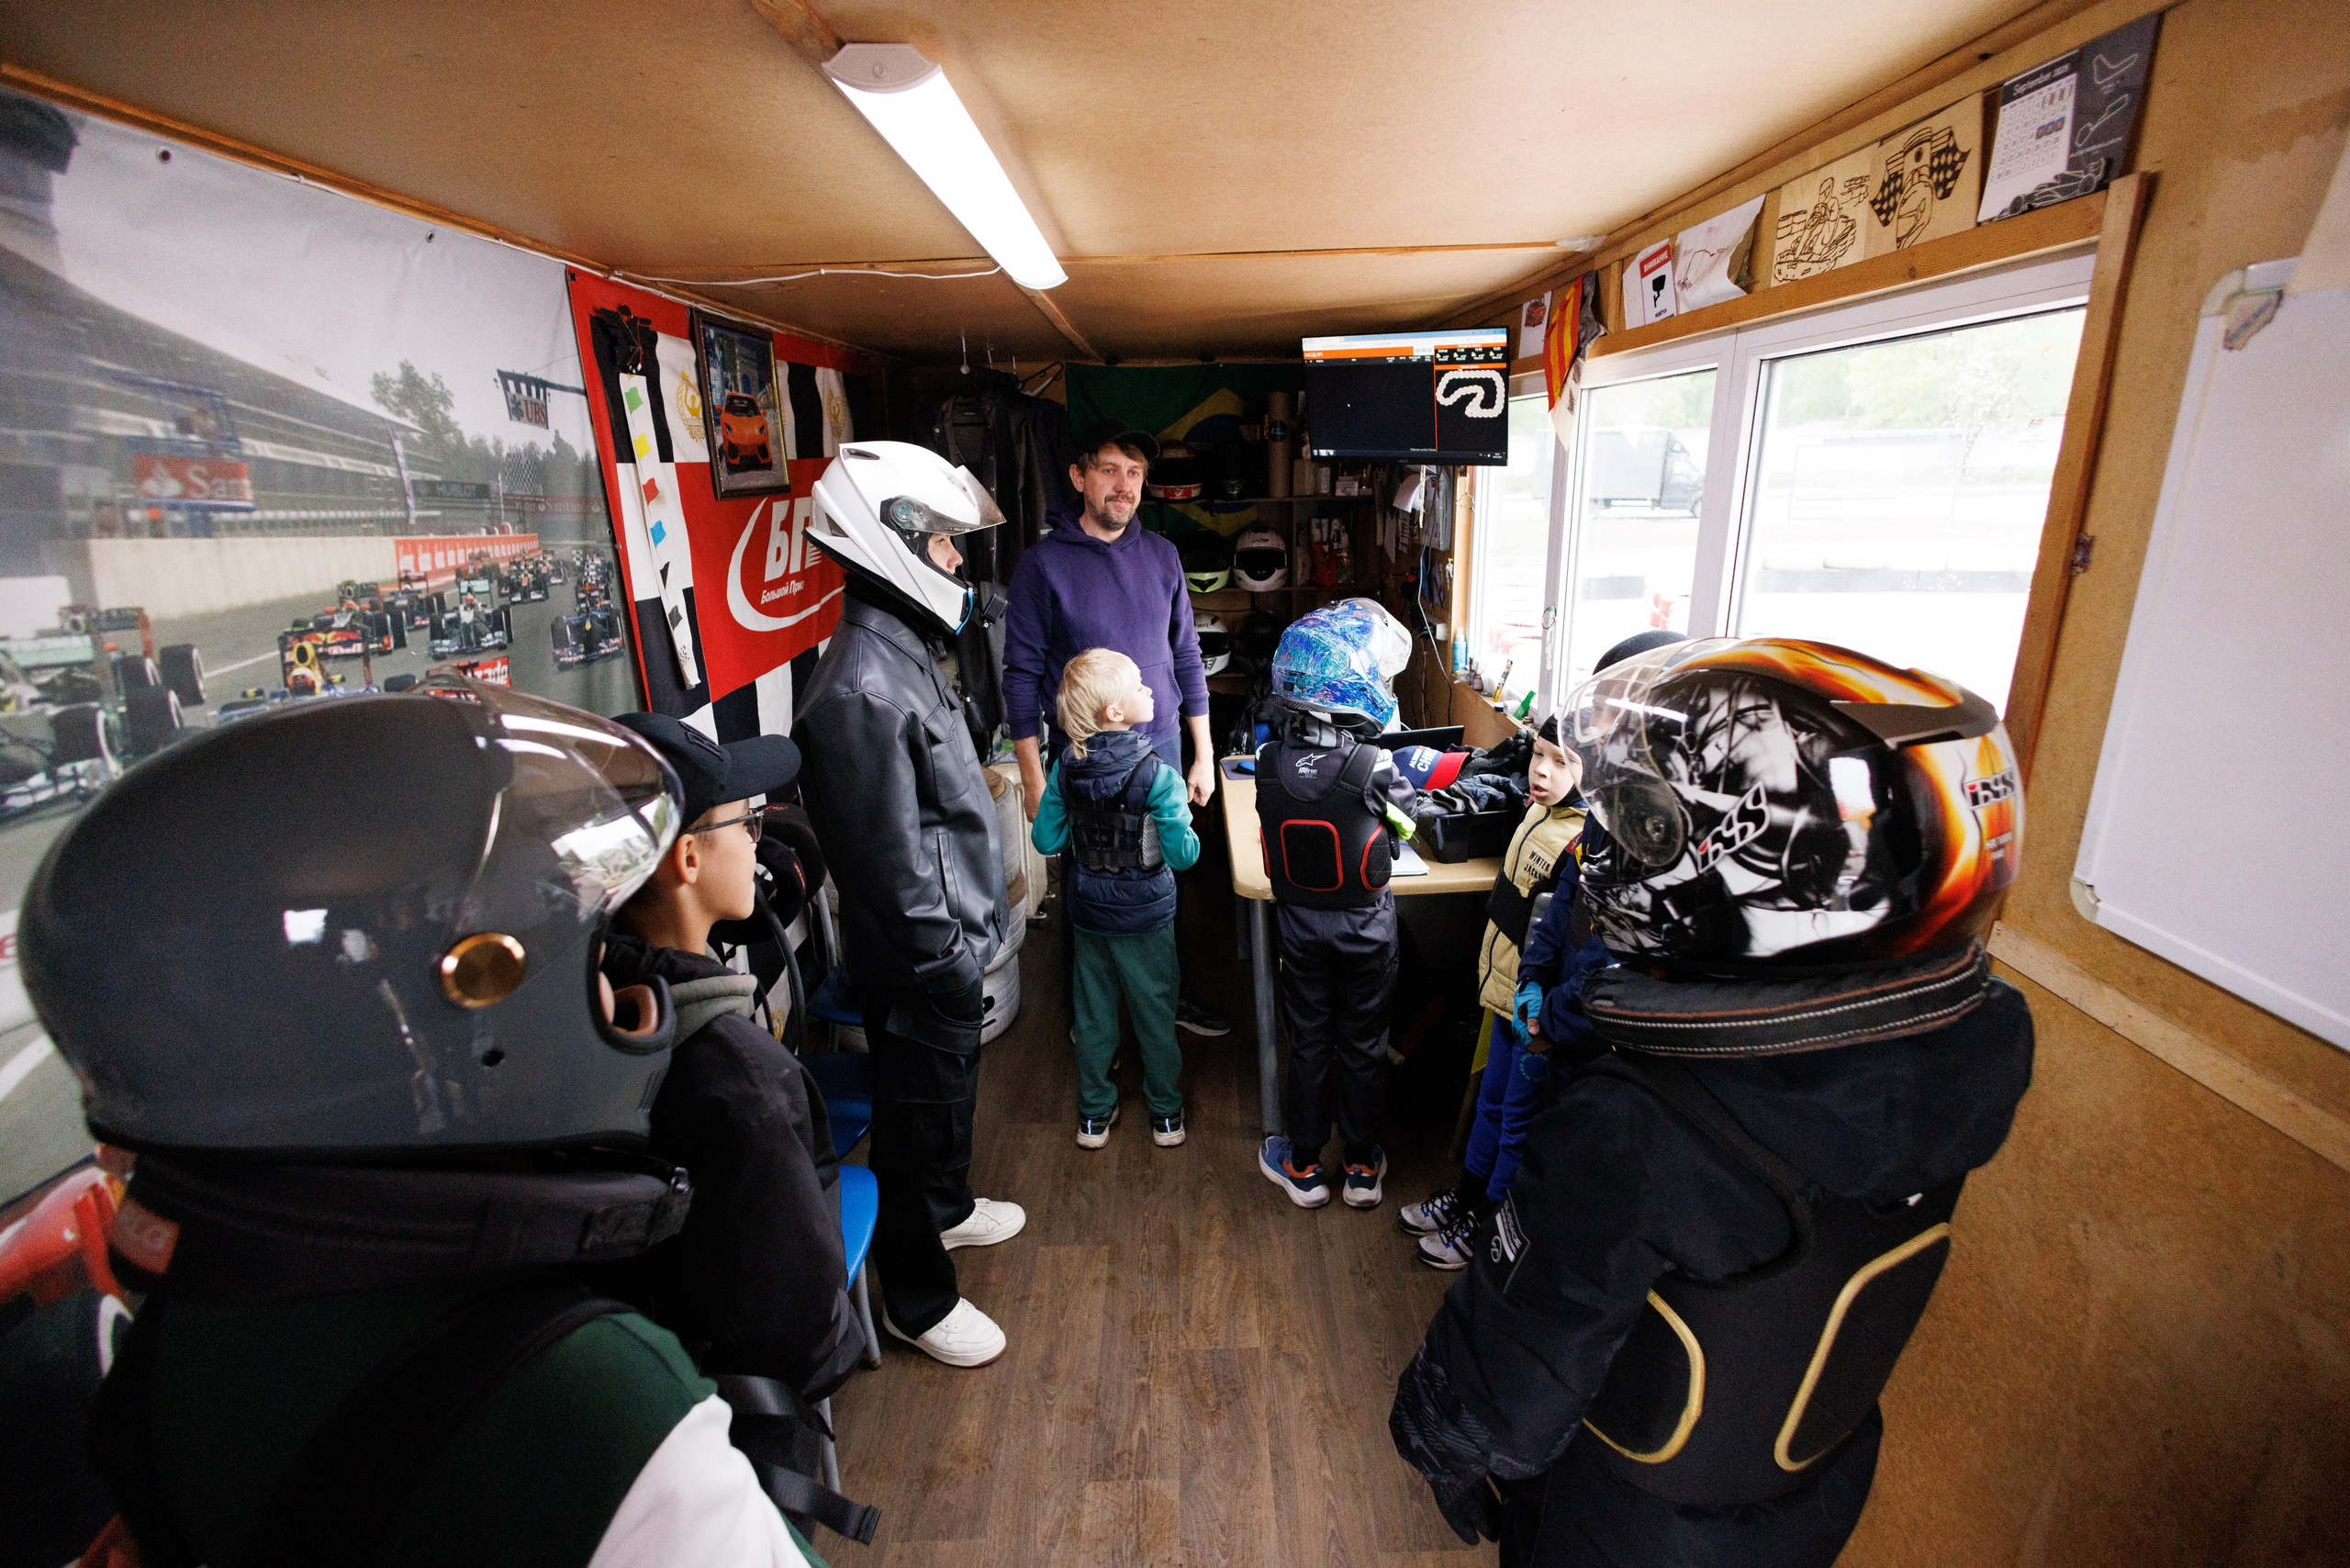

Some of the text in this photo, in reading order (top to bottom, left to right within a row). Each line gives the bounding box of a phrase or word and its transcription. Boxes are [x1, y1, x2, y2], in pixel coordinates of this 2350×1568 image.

[1643, 250, 1669, 273] ВНИМАНИЕ
[523, 399, 547, 425] UBS
[760, 582, 789, 605] Большой
[1524, 863, 1543, 880] JACKE
[1528, 850, 1550, 872] WINTER
